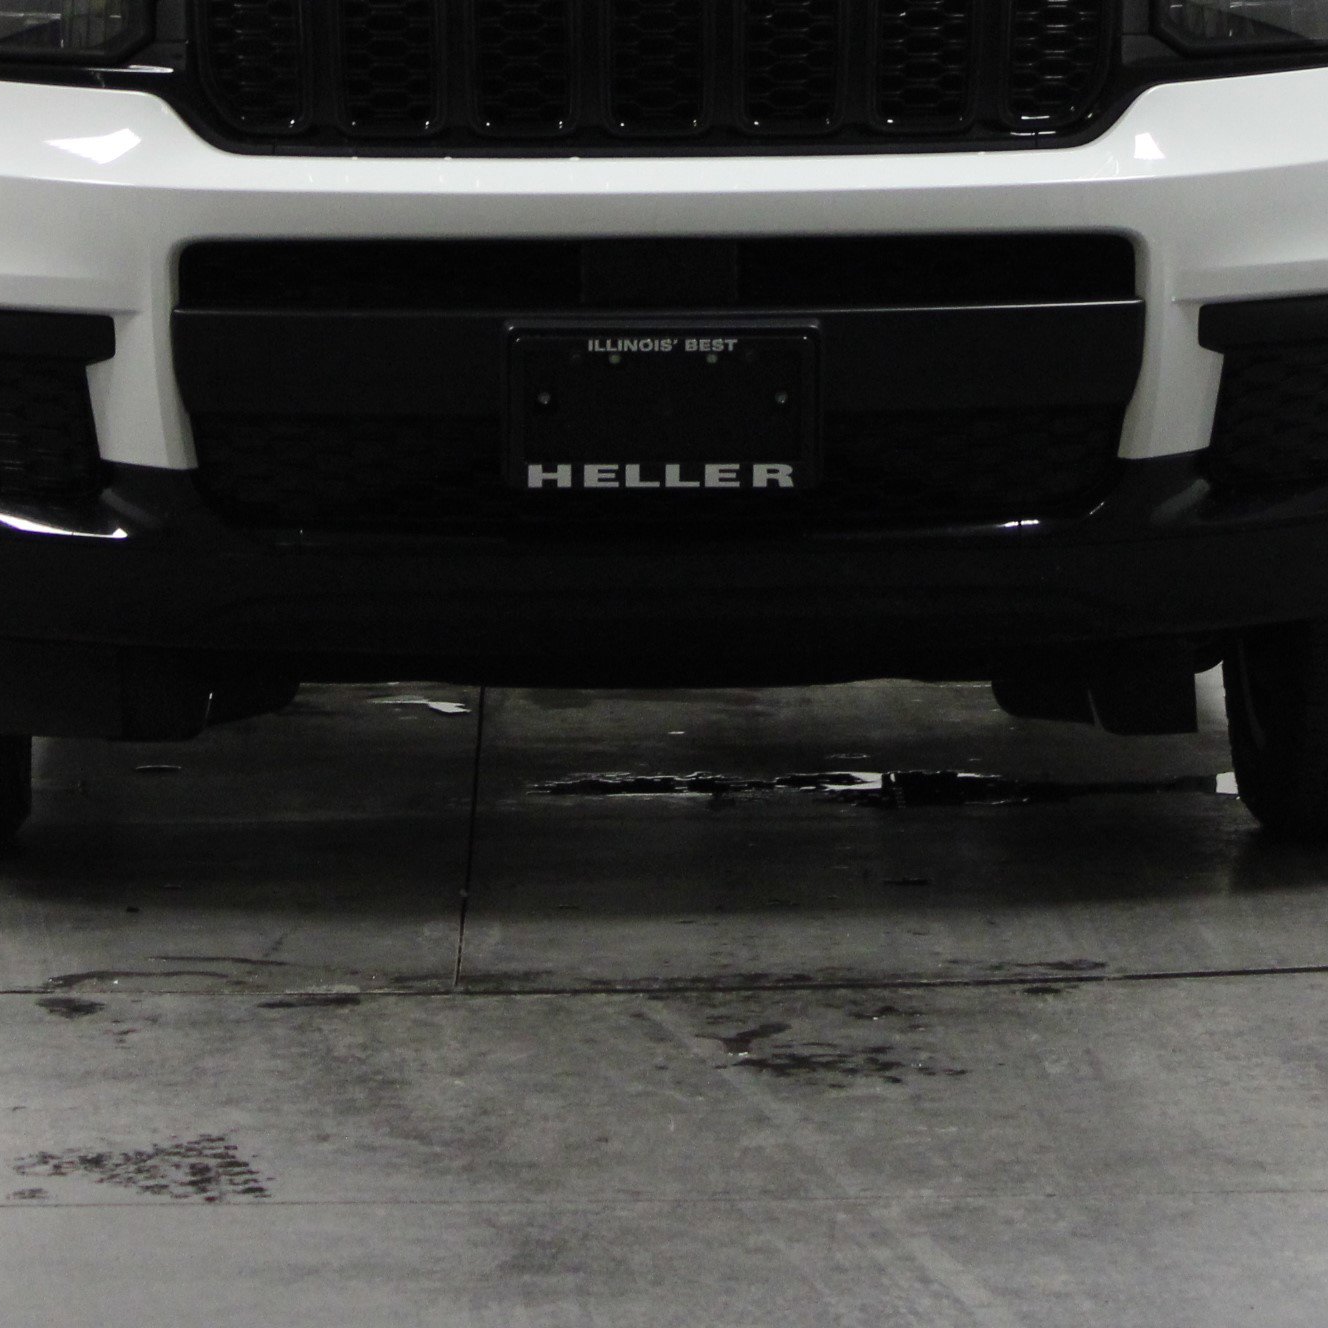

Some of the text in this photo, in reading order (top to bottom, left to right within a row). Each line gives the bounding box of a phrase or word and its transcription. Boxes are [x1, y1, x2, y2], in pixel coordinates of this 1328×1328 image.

[587, 338, 738, 352] ILLINOIS' BEST
[527, 463, 794, 488] HELLER
